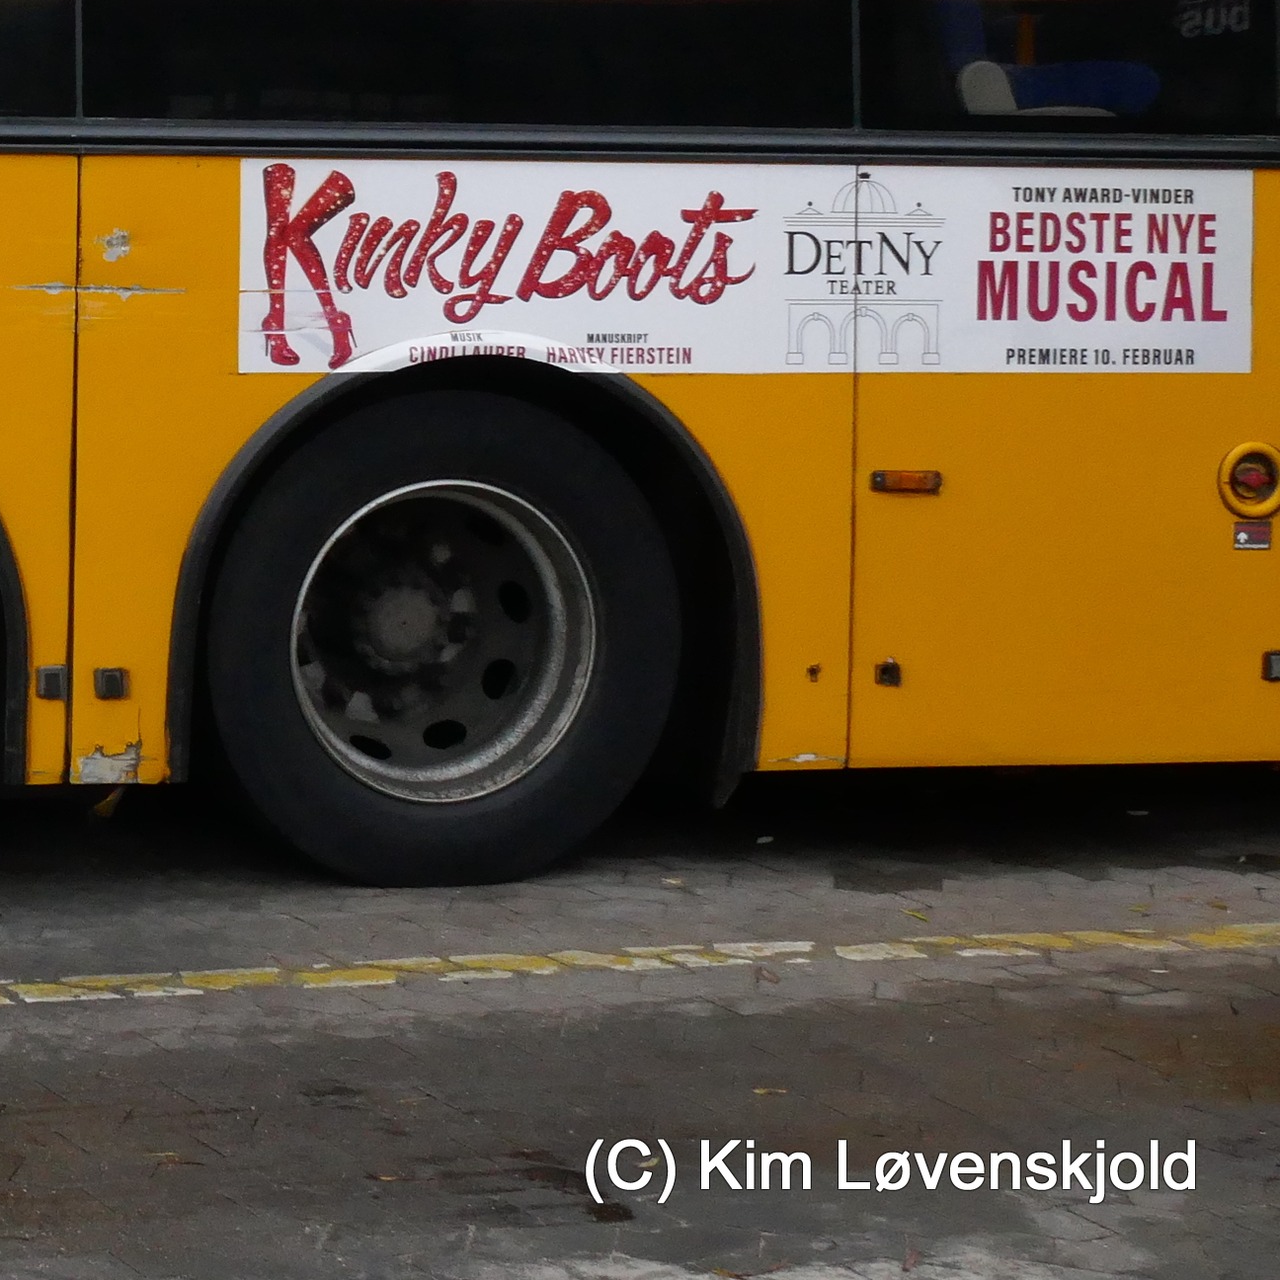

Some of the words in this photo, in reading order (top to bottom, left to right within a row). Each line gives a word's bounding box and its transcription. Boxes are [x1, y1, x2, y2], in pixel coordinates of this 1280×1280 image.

[1012, 187, 1057, 203] TONY
[1062, 188, 1194, 204] AWARD-VINDER
[989, 211, 1133, 254] BEDSTE
[1147, 213, 1217, 254] NYE
[262, 163, 524, 369] Kinky
[516, 190, 759, 305] Boots
[827, 280, 897, 295] TEATER
[977, 259, 1228, 323] MUSICAL
[450, 332, 483, 342] MUSIK
[587, 333, 648, 344] MANUSKRIPT
[546, 346, 605, 364] HARVEY
[610, 347, 692, 365] FIERSTEIN
[1006, 348, 1088, 365] PREMIERE
[1093, 349, 1116, 365] 10.
[1122, 349, 1195, 366] FEBRUAR
